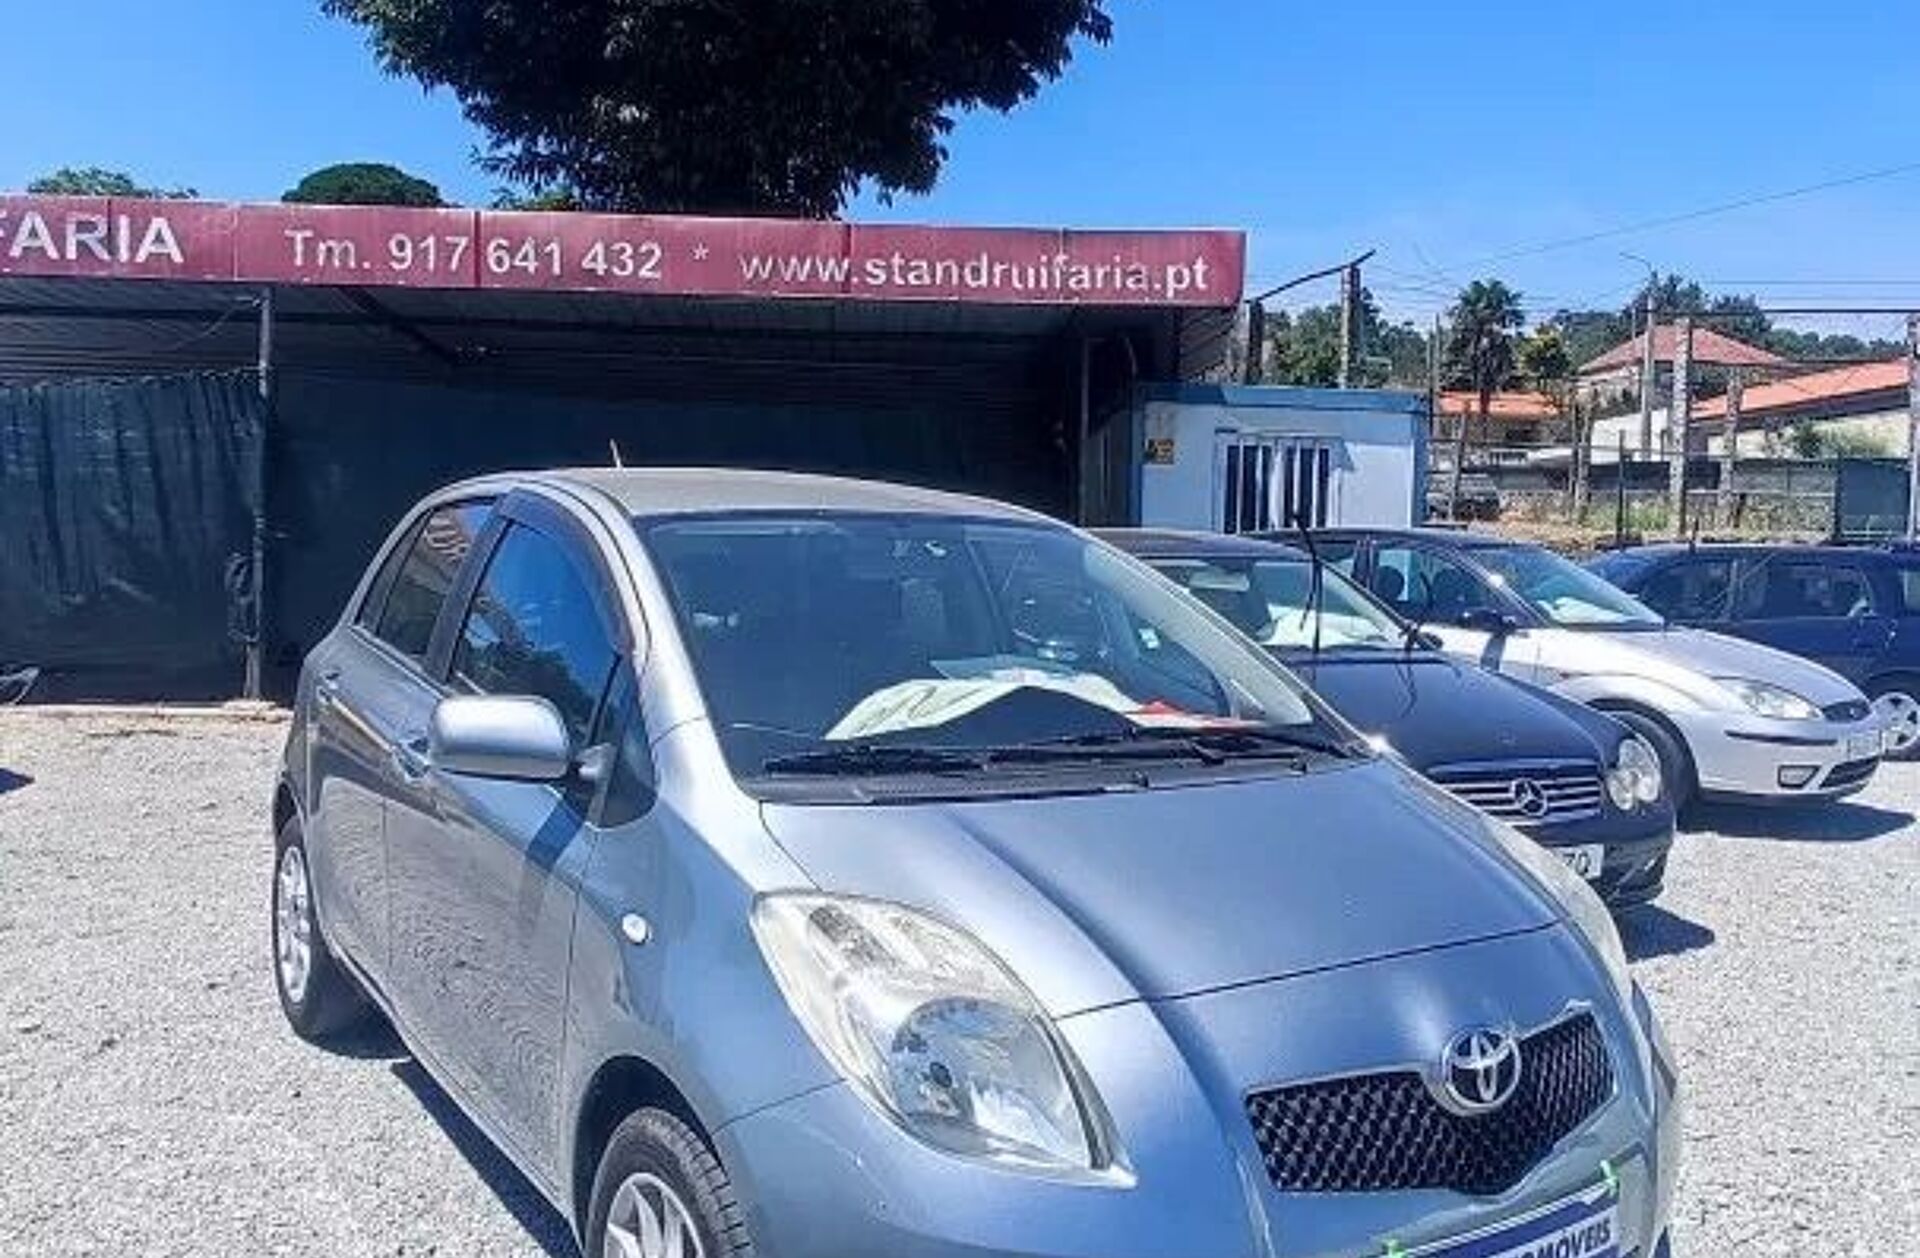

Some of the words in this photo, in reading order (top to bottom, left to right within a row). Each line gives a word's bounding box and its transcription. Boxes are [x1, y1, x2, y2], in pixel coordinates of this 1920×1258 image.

[284, 229, 371, 269] Tm.
[388, 233, 470, 272] 917
[486, 237, 562, 276] 641
[581, 240, 663, 279] 432
[738, 252, 1208, 298] www.standruifaria.pt
